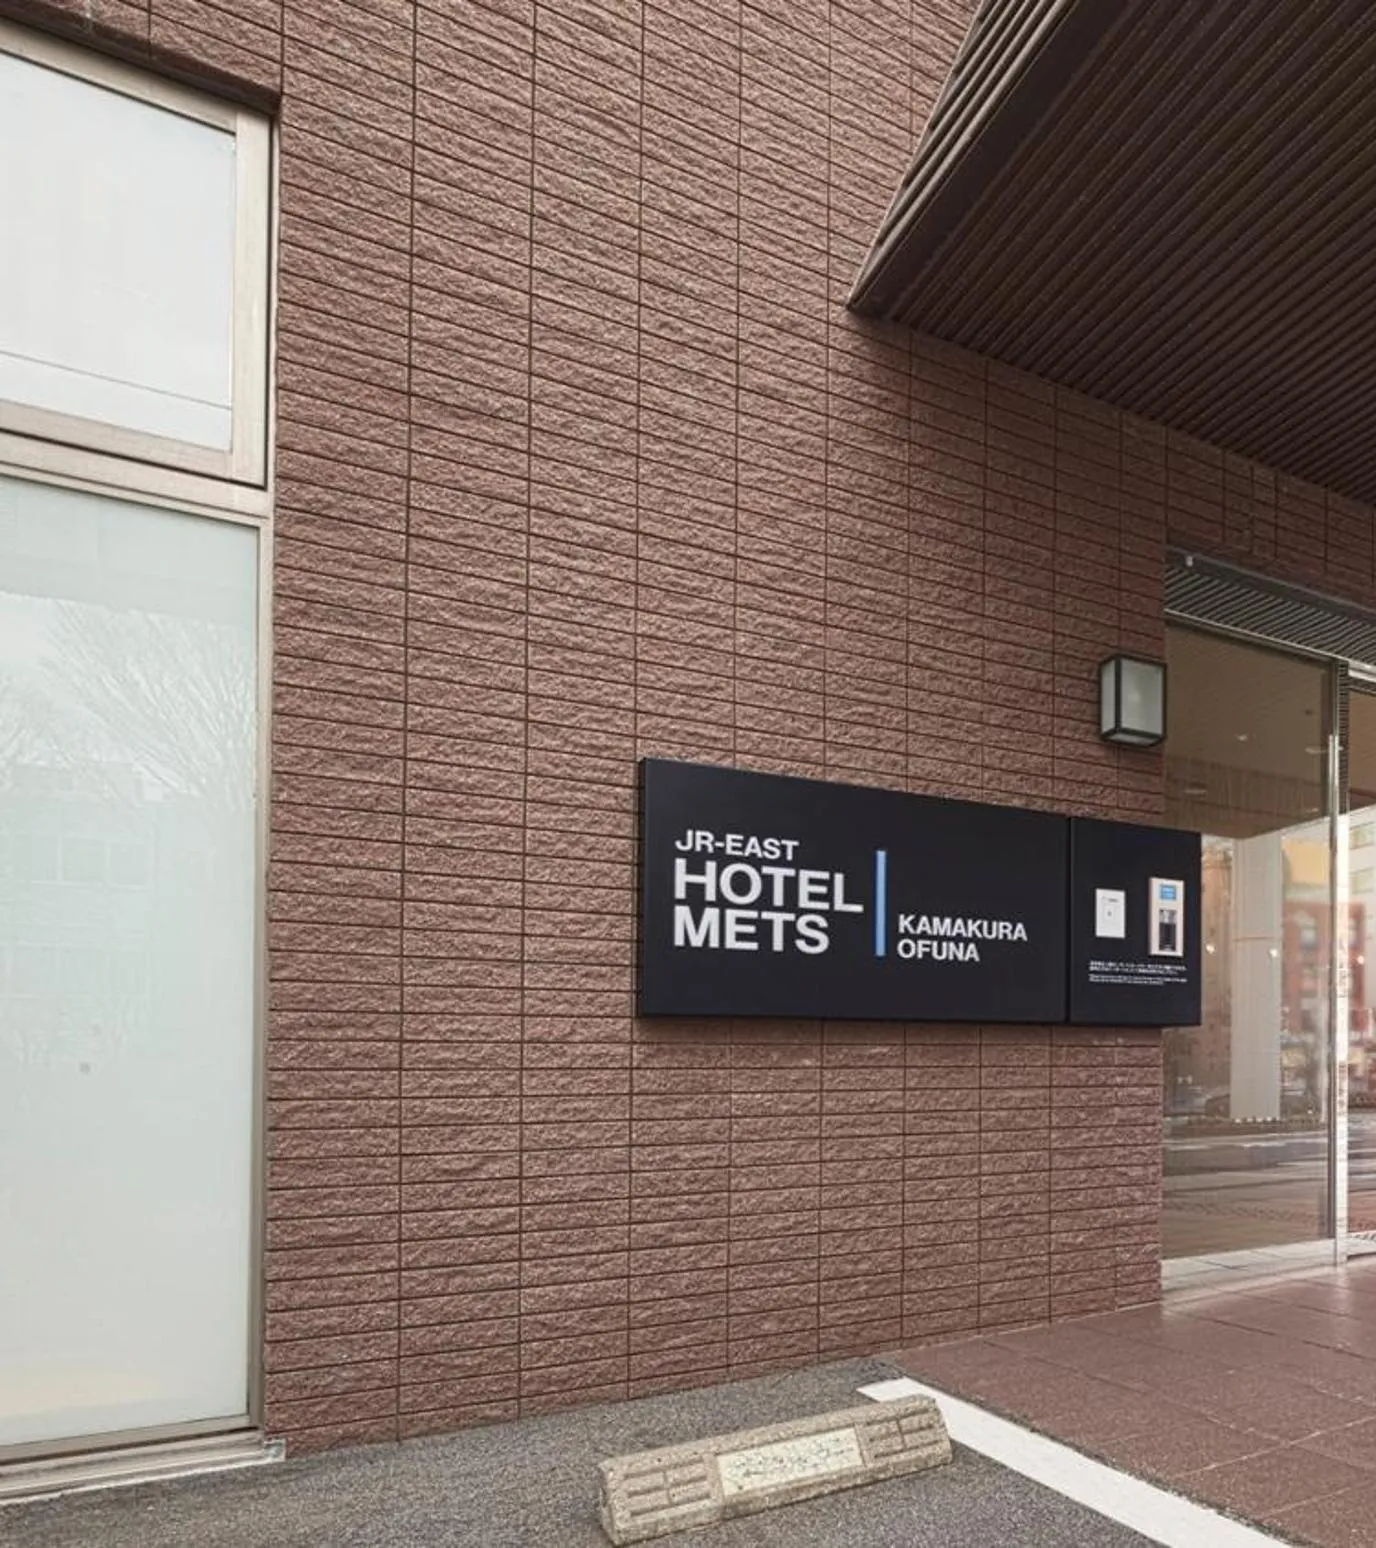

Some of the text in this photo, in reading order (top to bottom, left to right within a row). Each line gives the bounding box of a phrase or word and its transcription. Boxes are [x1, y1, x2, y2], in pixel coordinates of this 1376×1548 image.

[675, 830, 799, 861] JR-EAST
[674, 858, 864, 913] HOTEL
[674, 905, 830, 954] METS
[899, 914, 1028, 942] KAMAKURA
[897, 938, 980, 962] OFUNA
